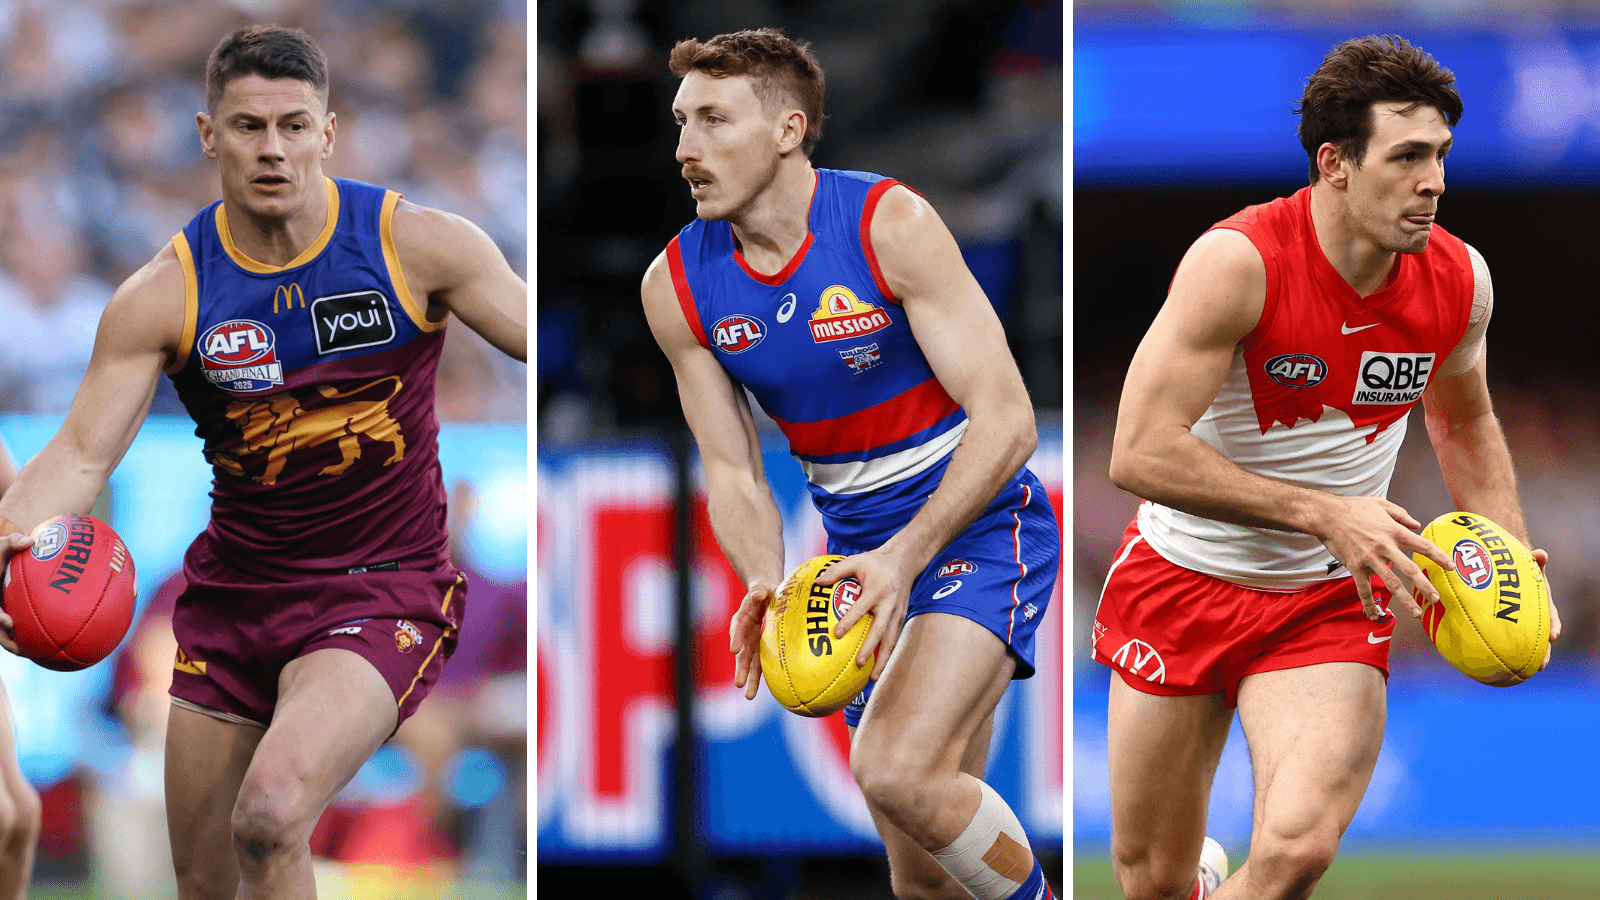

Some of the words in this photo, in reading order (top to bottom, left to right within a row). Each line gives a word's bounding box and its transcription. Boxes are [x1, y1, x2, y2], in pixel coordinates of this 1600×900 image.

[323, 299, 382, 343] youi
[716, 322, 762, 346] AFL
[813, 312, 886, 338] MISSION
[206, 328, 269, 356] AFL
[841, 344, 878, 357] BULLDOGS
[206, 368, 240, 383] GRAND
[241, 365, 279, 381] FINAL
[1269, 361, 1321, 382] AFL
[1362, 355, 1432, 390] QBE
[233, 380, 253, 390] 2025
[1356, 389, 1422, 402] INSURANCE
[37, 524, 60, 559] AFL
[49, 514, 94, 594] HERRIN
[940, 563, 973, 576] AFL
[1451, 515, 1521, 624] SHERRIN
[1456, 545, 1488, 588] AFL
[807, 556, 846, 657] SHER
[396, 619, 423, 645] LIONS
